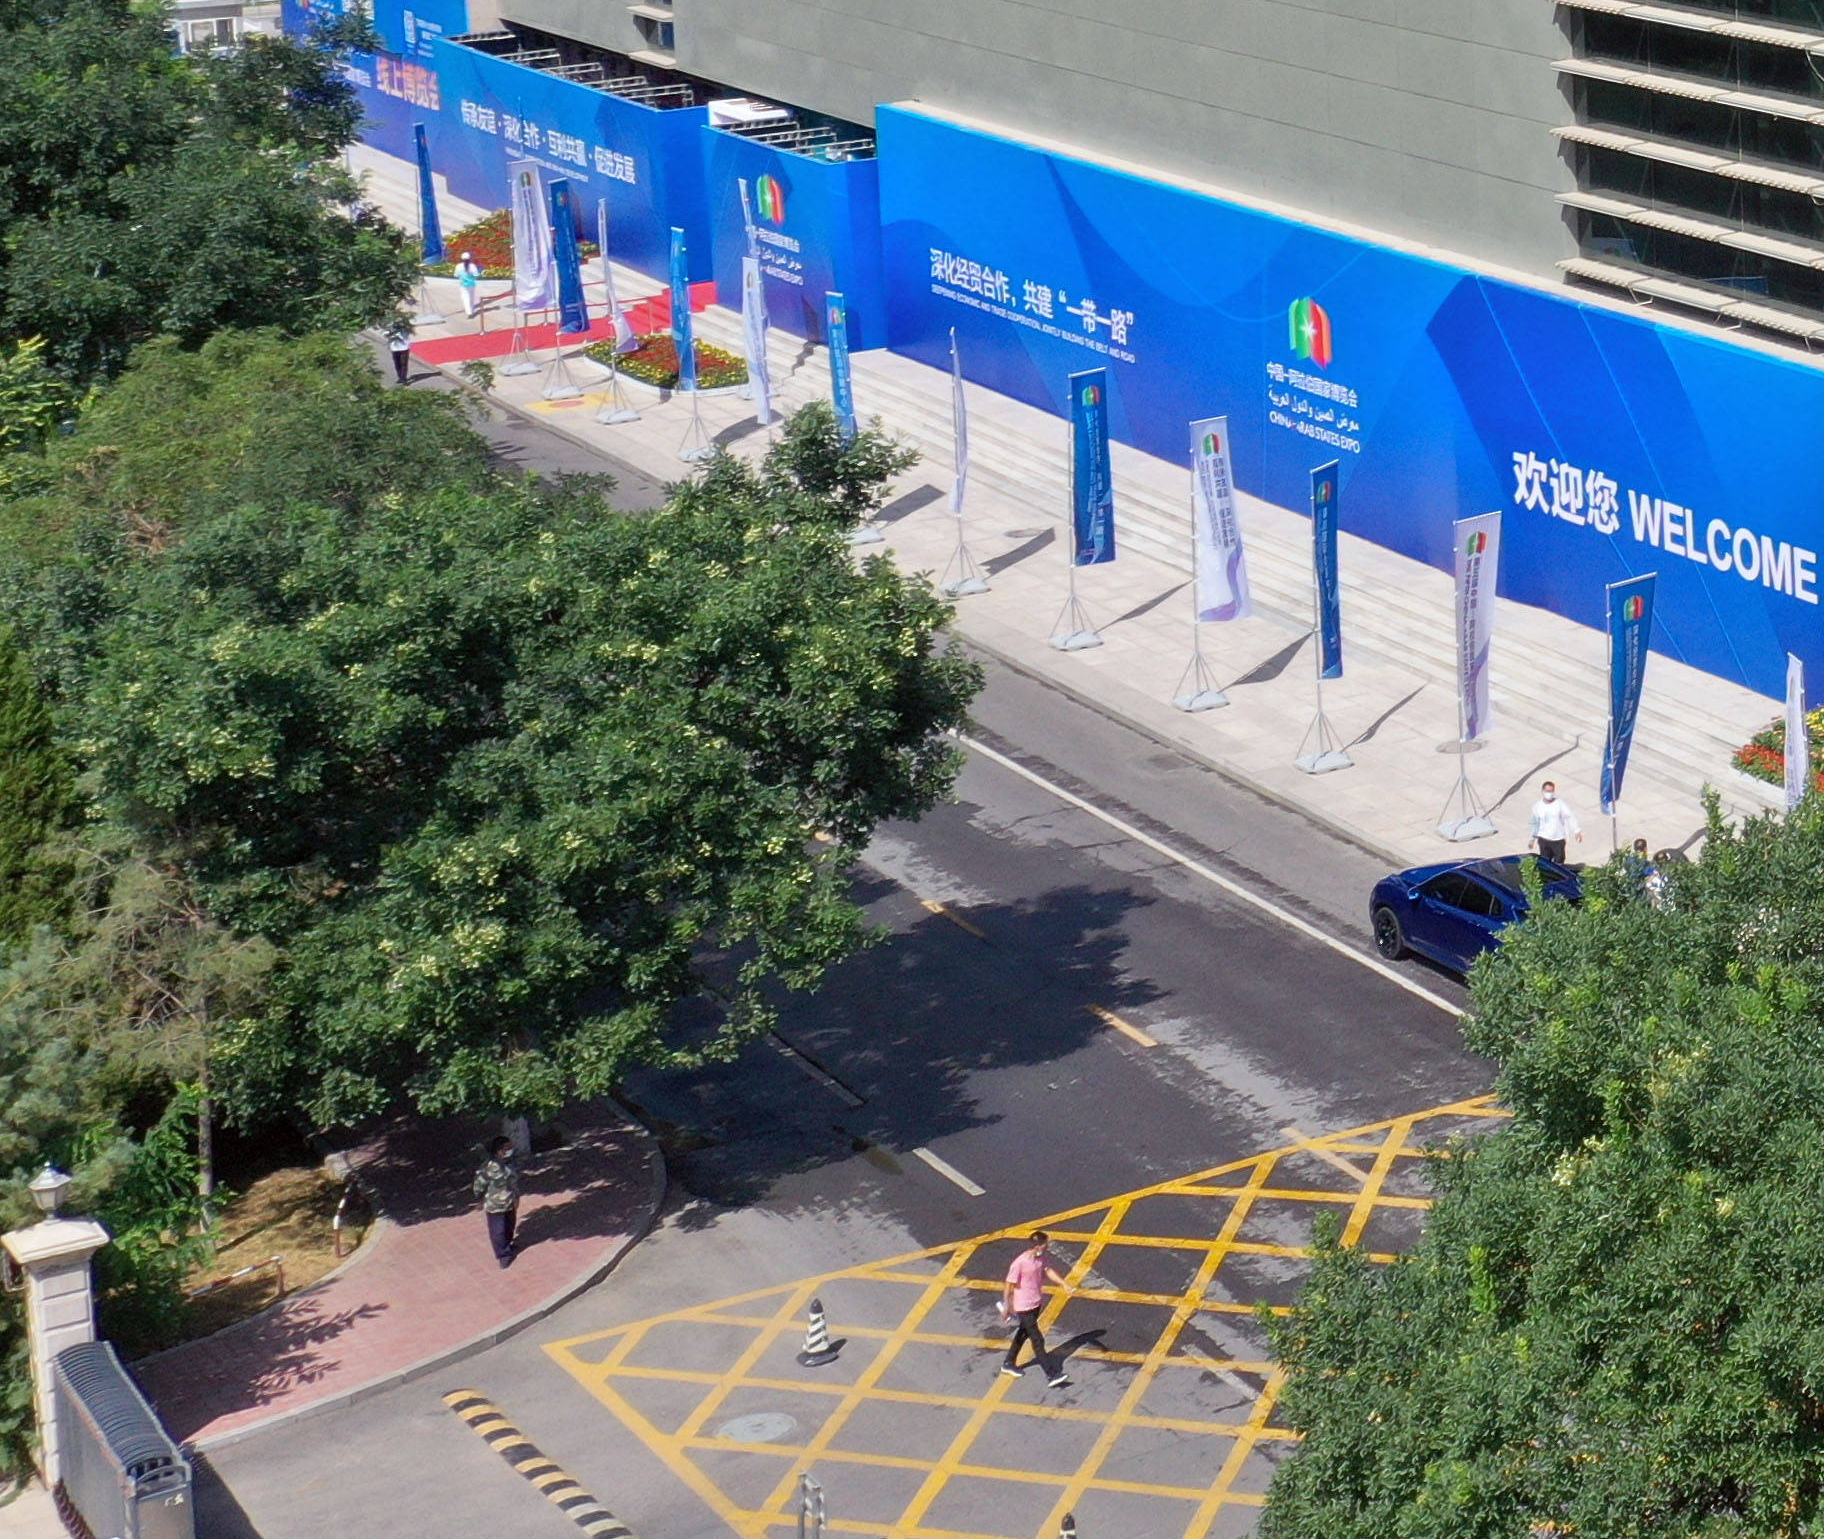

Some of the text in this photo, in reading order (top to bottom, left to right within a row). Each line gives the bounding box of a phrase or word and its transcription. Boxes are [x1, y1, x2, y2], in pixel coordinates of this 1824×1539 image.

[1315, 426, 1340, 447] STATES
[1340, 436, 1360, 454] EXPO
[1512, 451, 1819, 605] 欢迎您 WELCOME
